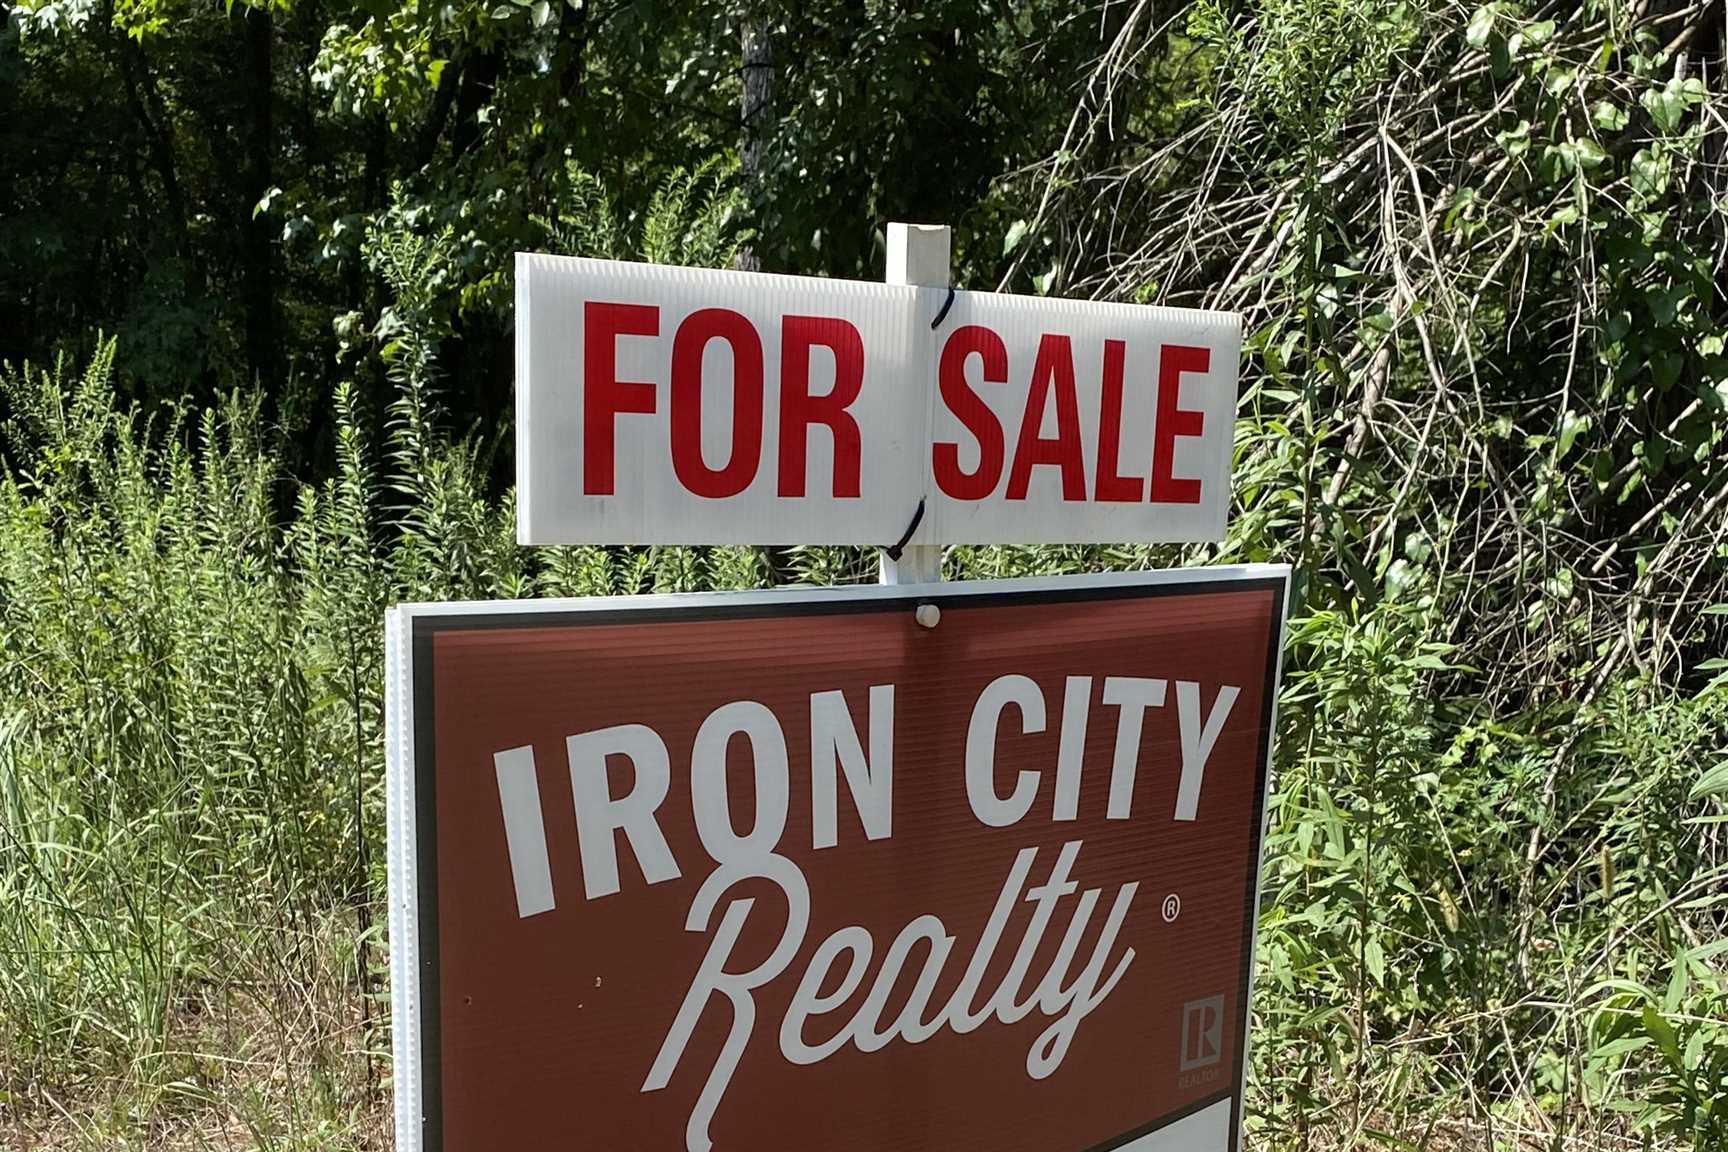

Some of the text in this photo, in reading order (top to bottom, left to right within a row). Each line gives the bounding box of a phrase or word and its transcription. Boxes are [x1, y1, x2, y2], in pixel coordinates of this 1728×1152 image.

[583, 301, 1211, 504] FOR SALE
[494, 675, 1241, 918] IRON CITY
